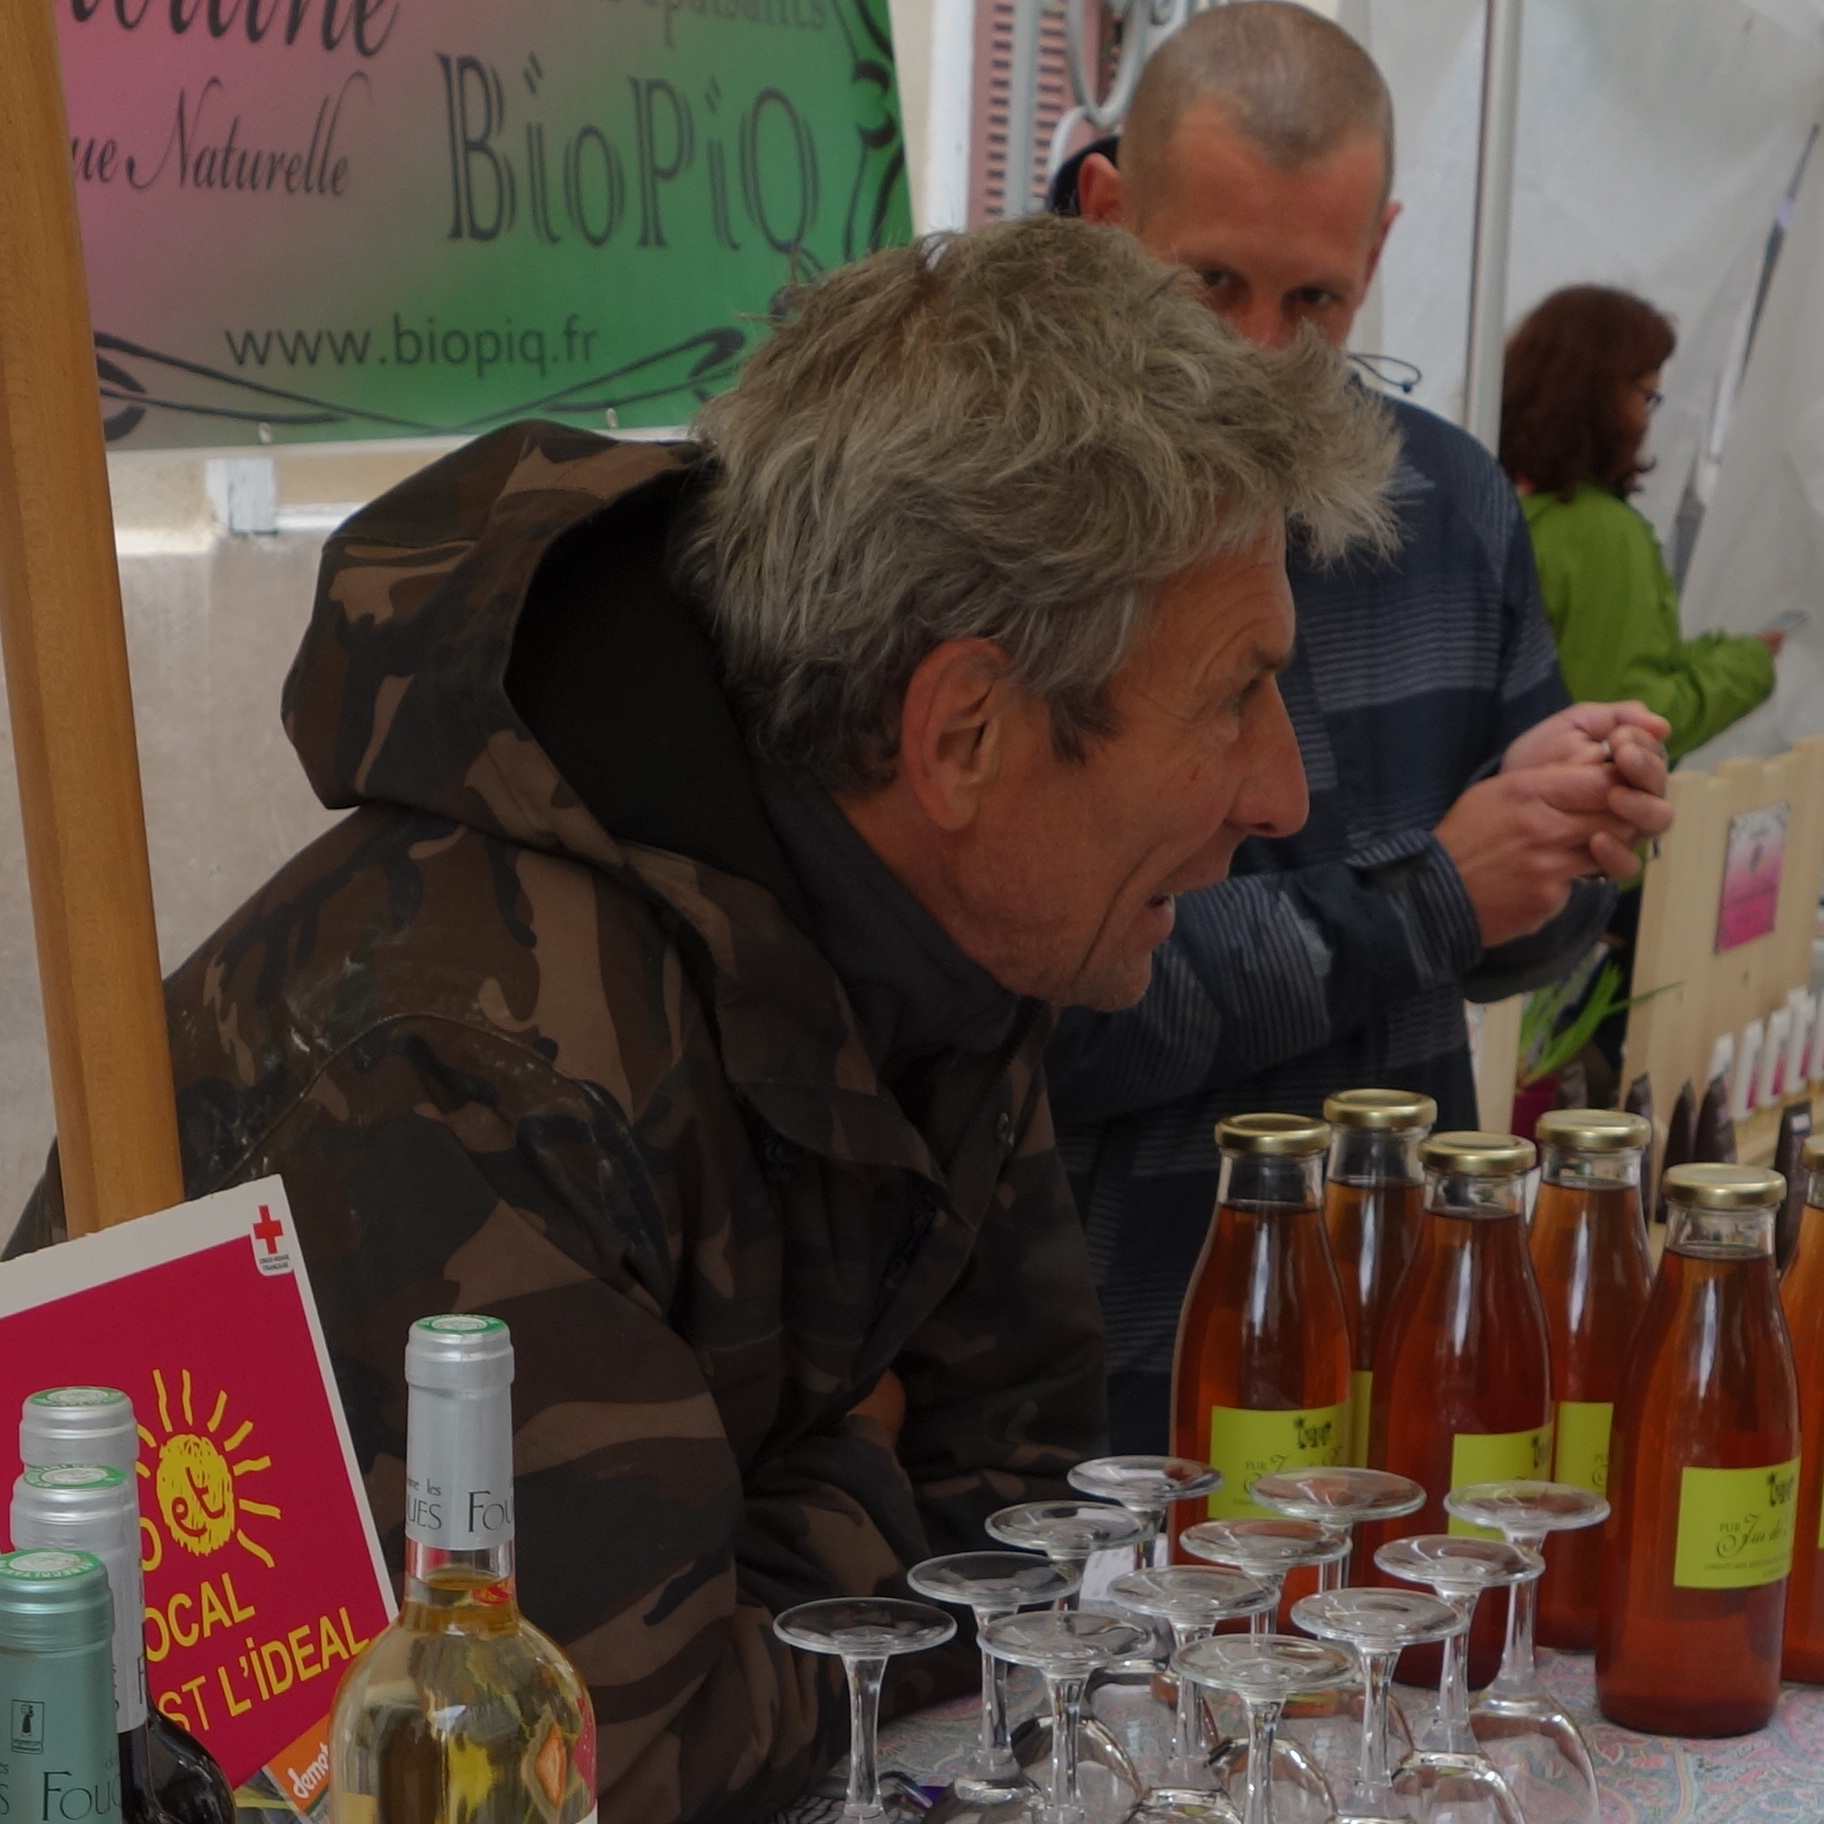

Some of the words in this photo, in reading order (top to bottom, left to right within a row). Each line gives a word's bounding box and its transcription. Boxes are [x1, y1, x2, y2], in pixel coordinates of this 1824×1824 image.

[126, 70, 372, 197] Naturelle
[225, 313, 598, 378] www.biopiq.fr
[143, 1572, 256, 1662] OCAL
